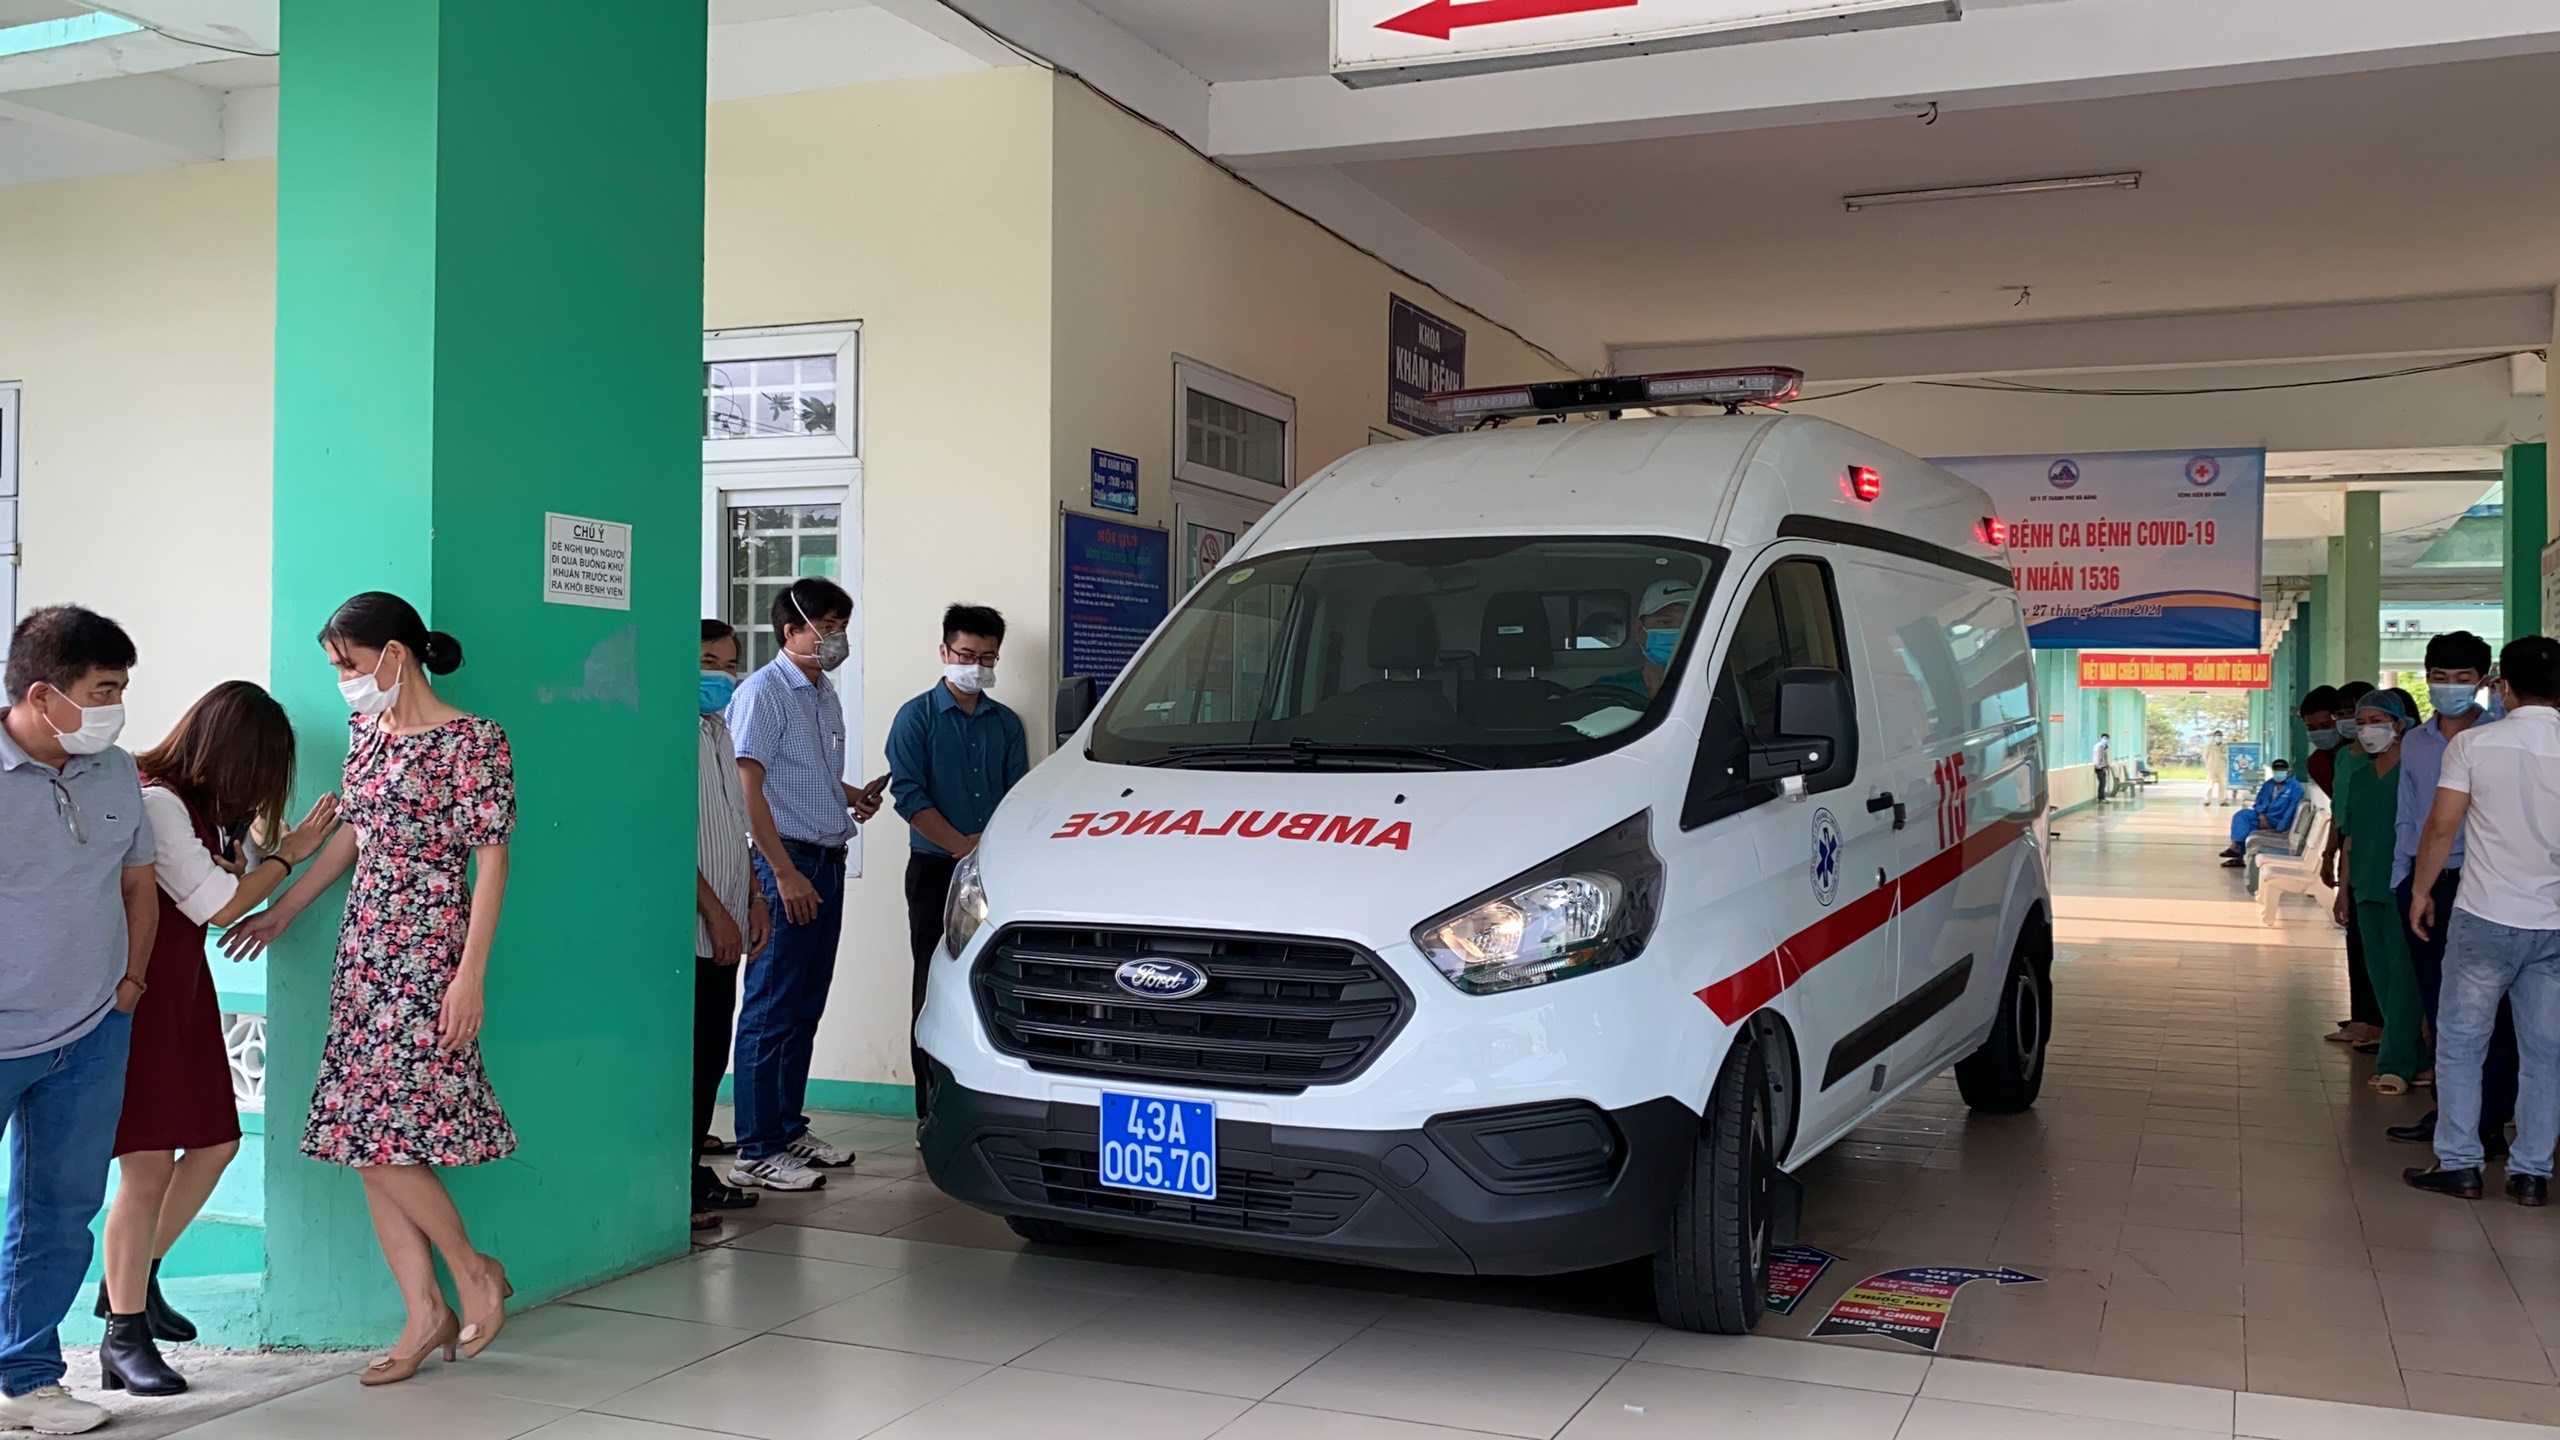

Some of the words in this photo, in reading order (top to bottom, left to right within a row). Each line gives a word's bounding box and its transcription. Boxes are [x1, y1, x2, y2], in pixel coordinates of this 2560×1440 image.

[1418, 322, 1440, 353] KHOA
[1396, 346, 1429, 392] KHÁM
[574, 523, 596, 539] CHÚ
[598, 524, 604, 540] Ý
[2009, 518, 2054, 554] BỆNH
[2059, 522, 2080, 548] CA
[2086, 516, 2131, 552] BỆNH
[2137, 520, 2216, 546] COVID-19
[552, 540, 562, 551] ĐỀ
[564, 543, 583, 556] NGHỊ
[585, 546, 598, 557] MỌI
[600, 548, 624, 559] NGƯỜI
[552, 554, 559, 564] ĐI
[561, 556, 578, 566] QUA
[580, 558, 606, 570] BUỒNG
[608, 561, 624, 572] KHỬ
[553, 568, 580, 579] KHUẨN
[582, 570, 608, 582] TRƯỚC
[610, 574, 622, 584] KHI
[2027, 561, 2074, 591] NHÂN
[2080, 566, 2120, 591] 1536
[552, 580, 563, 590] RA
[564, 581, 583, 592] KHỎI
[584, 584, 605, 595] BỆNH
[606, 586, 623, 598] VIỆN
[2032, 604, 2048, 616] 27
[2050, 604, 2091, 620] tháng
[2101, 604, 2132, 616] năm
[2134, 604, 2163, 617] 2021
[2083, 658, 2098, 685] VIỆT
[2099, 663, 2117, 680] NAM
[2118, 656, 2140, 680] CHIẾN
[2141, 656, 2165, 680] THẮNG
[2166, 663, 2187, 681] COVID
[2193, 656, 2215, 681] CHẤM
[2216, 659, 2230, 681] DỨT
[2232, 659, 2252, 686] BỆNH
[2253, 664, 2267, 682] LAO
[1934, 752, 1968, 850] 115
[1130, 964, 1188, 990] Ford
[1126, 1098, 1187, 1146] 43A
[1104, 1140, 1211, 1193] 005.70
[1912, 1286, 1949, 1295] COPD
[1854, 1294, 1900, 1303] THUỐC
[1905, 1300, 1943, 1308] BHYT
[1840, 1306, 1881, 1315] HÀNH
[1884, 1311, 1931, 1321] CHÍNH
[1830, 1317, 1876, 1327] KHOA
[1882, 1324, 1931, 1334] DƯỢC
